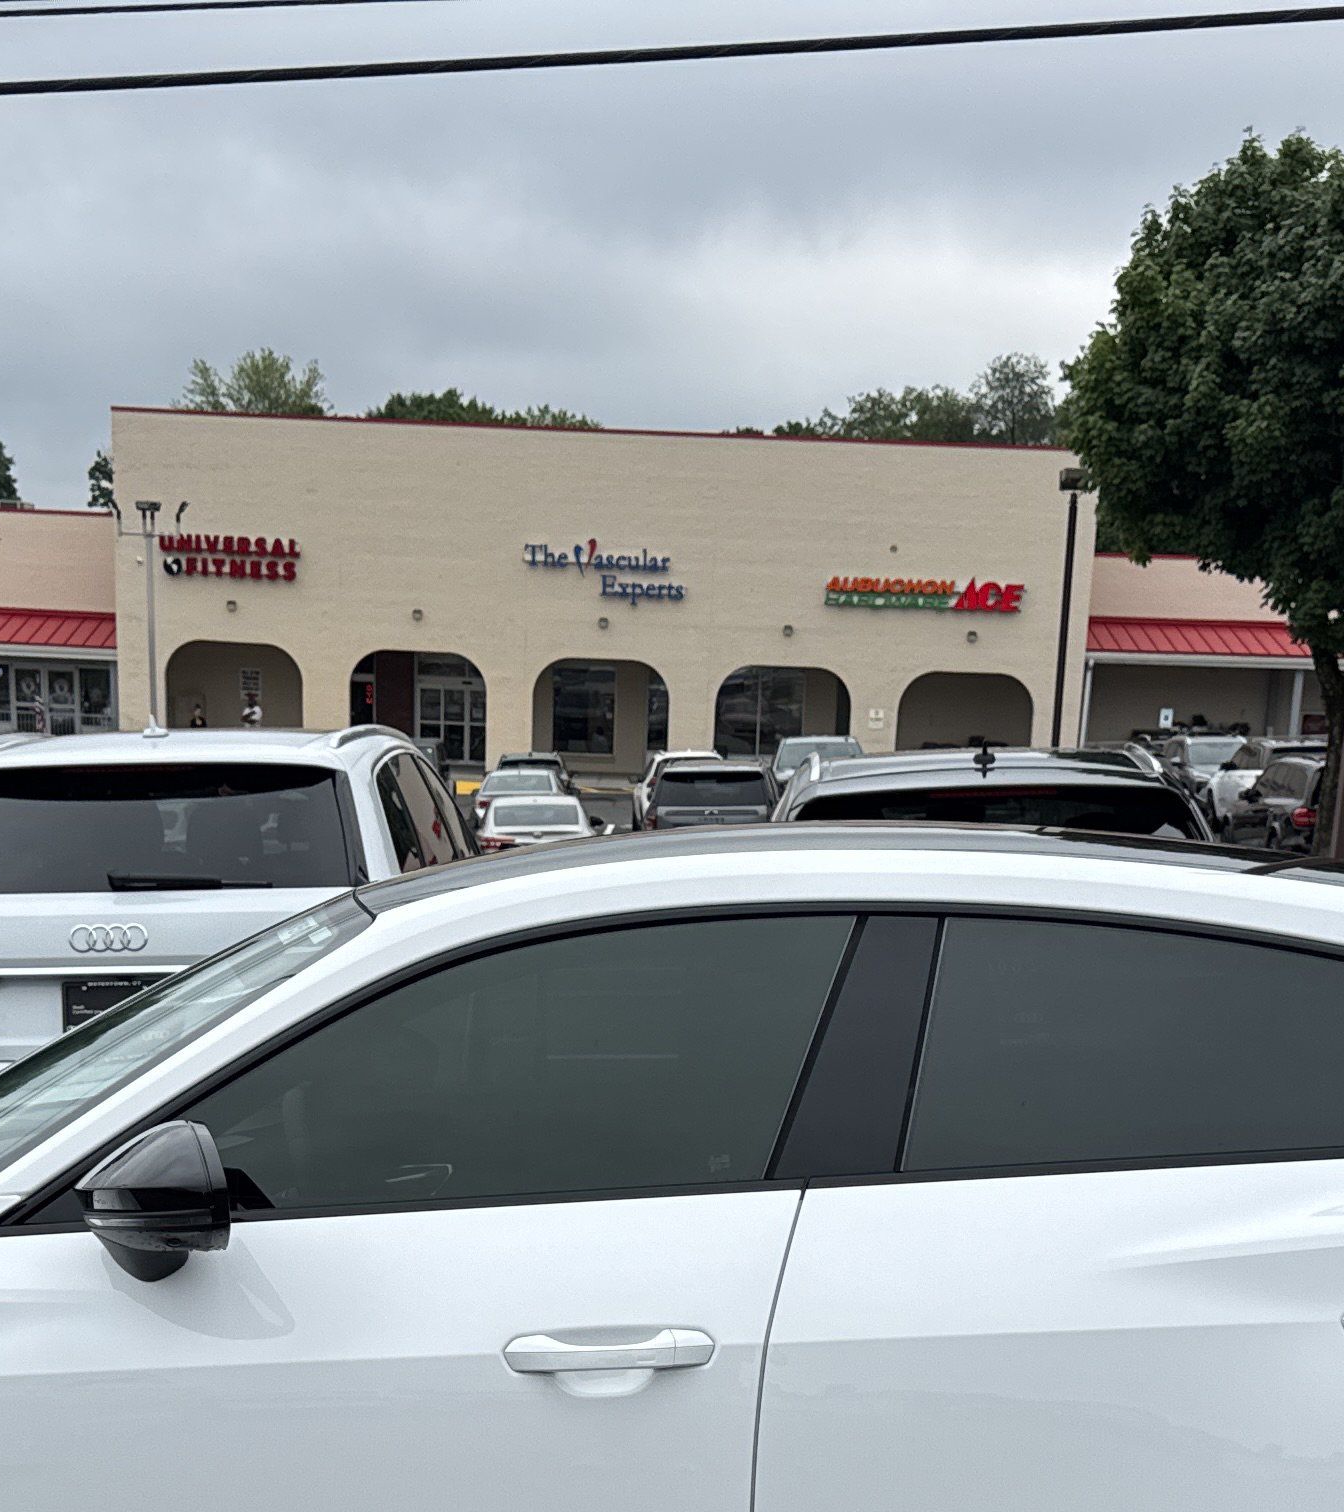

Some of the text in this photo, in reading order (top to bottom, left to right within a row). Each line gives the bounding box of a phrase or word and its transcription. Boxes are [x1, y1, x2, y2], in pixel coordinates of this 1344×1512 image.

[159, 533, 301, 559] UNIVERSAL
[524, 538, 671, 578] The Vascular
[184, 556, 297, 582] FITNESS
[600, 574, 686, 606] Experts
[826, 576, 956, 595] AUBUCHON
[953, 576, 1028, 613] ACE
